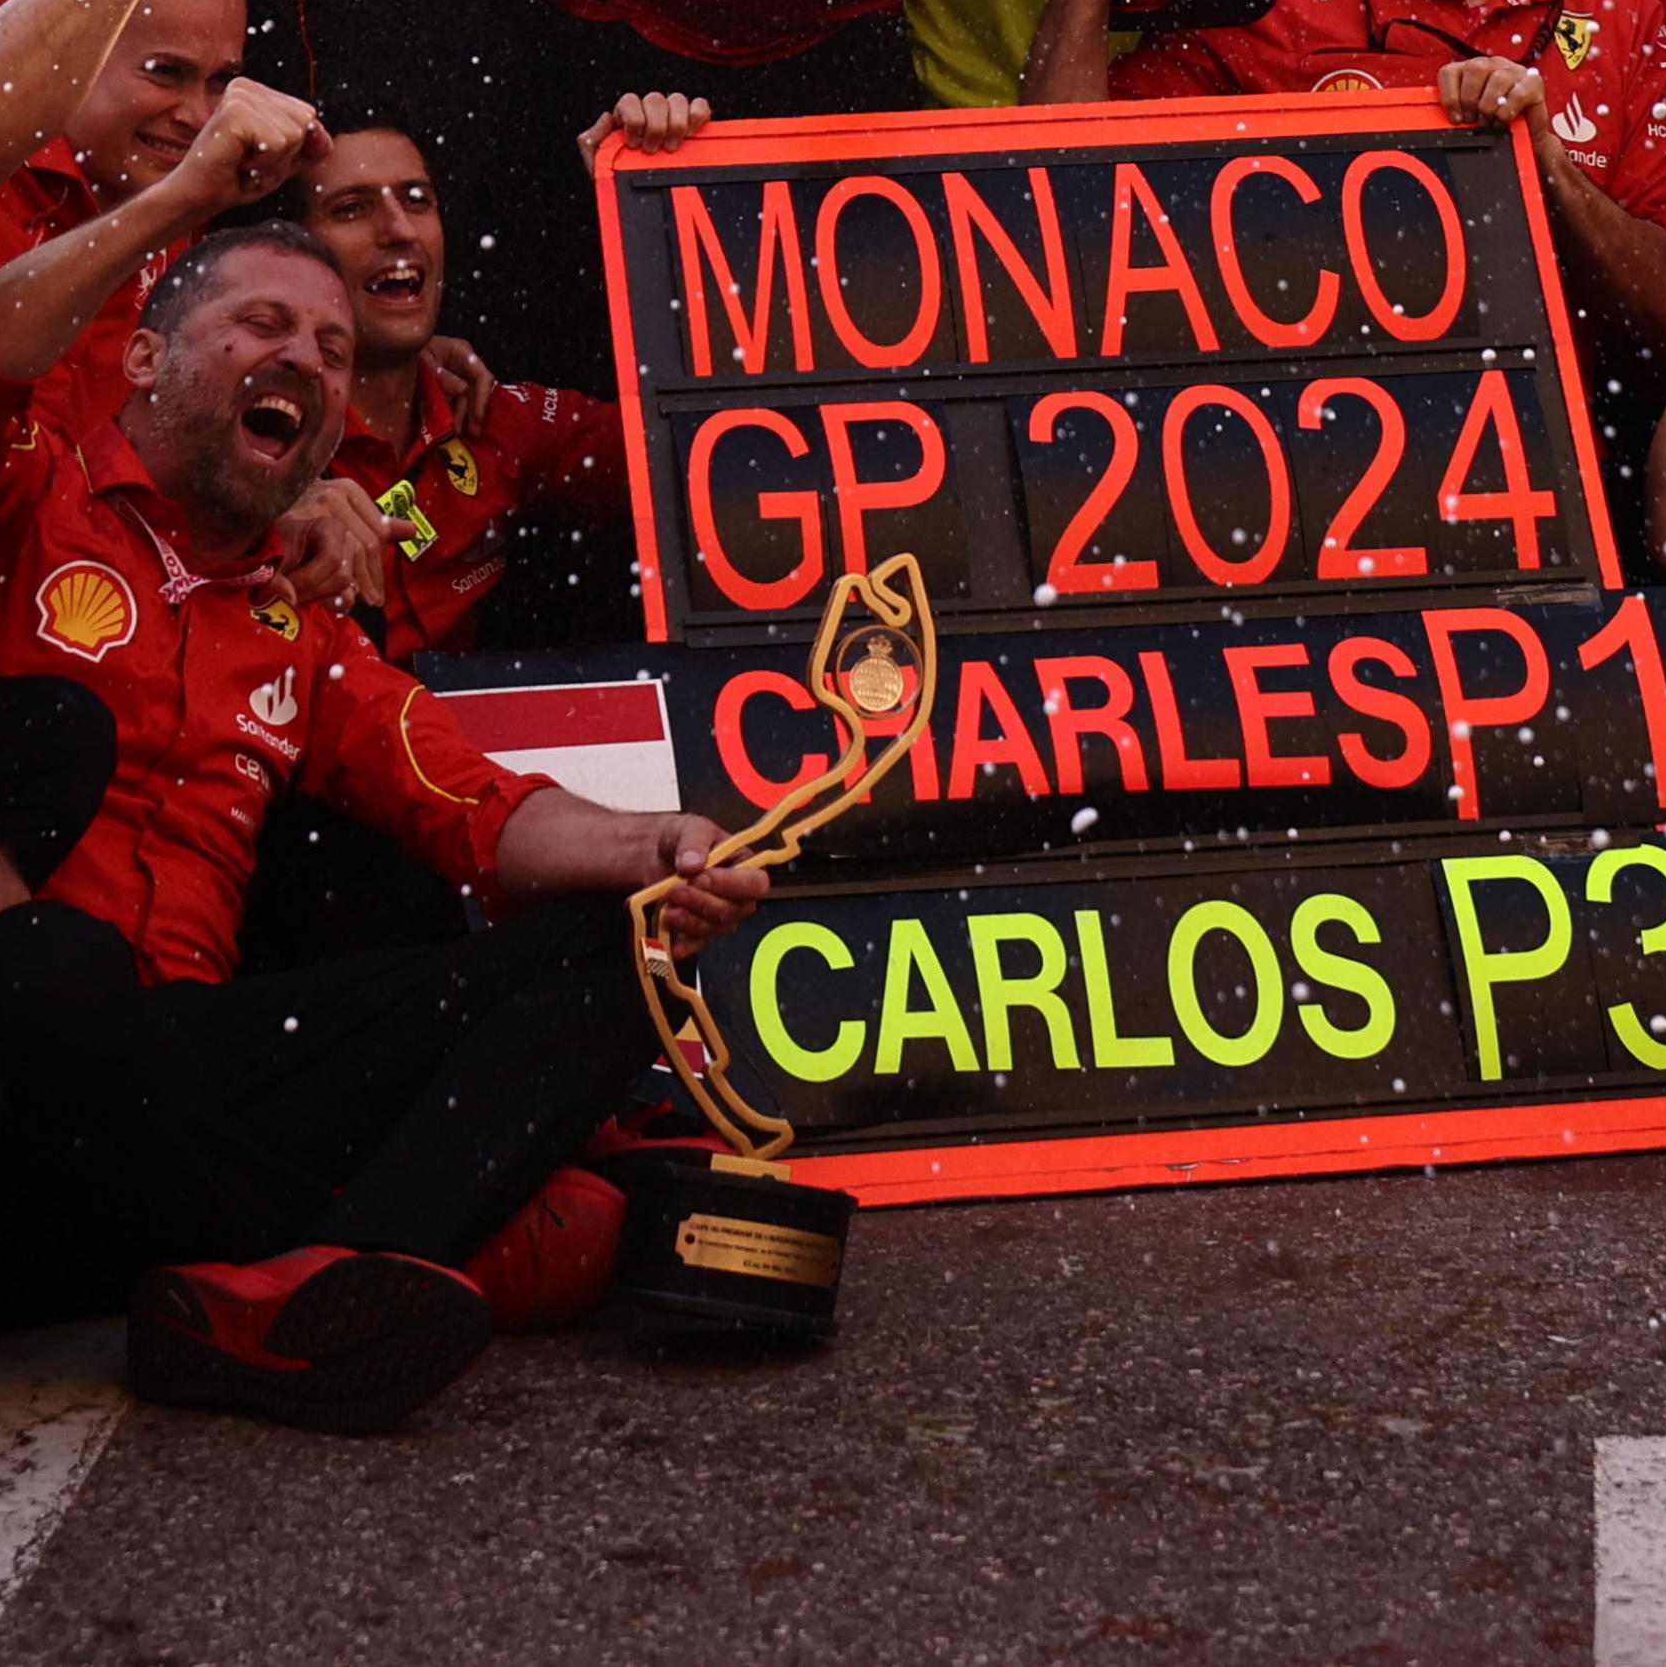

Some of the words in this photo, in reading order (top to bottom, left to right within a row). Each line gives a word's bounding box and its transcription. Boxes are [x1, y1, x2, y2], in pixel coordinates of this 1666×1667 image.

[670, 149, 1467, 378] MONACO
[688, 401, 945, 612] GP
[1028, 370, 1557, 594] 2024
[713, 636, 1431, 812] CHARLES
[749, 892, 1397, 1083] CARLOS
